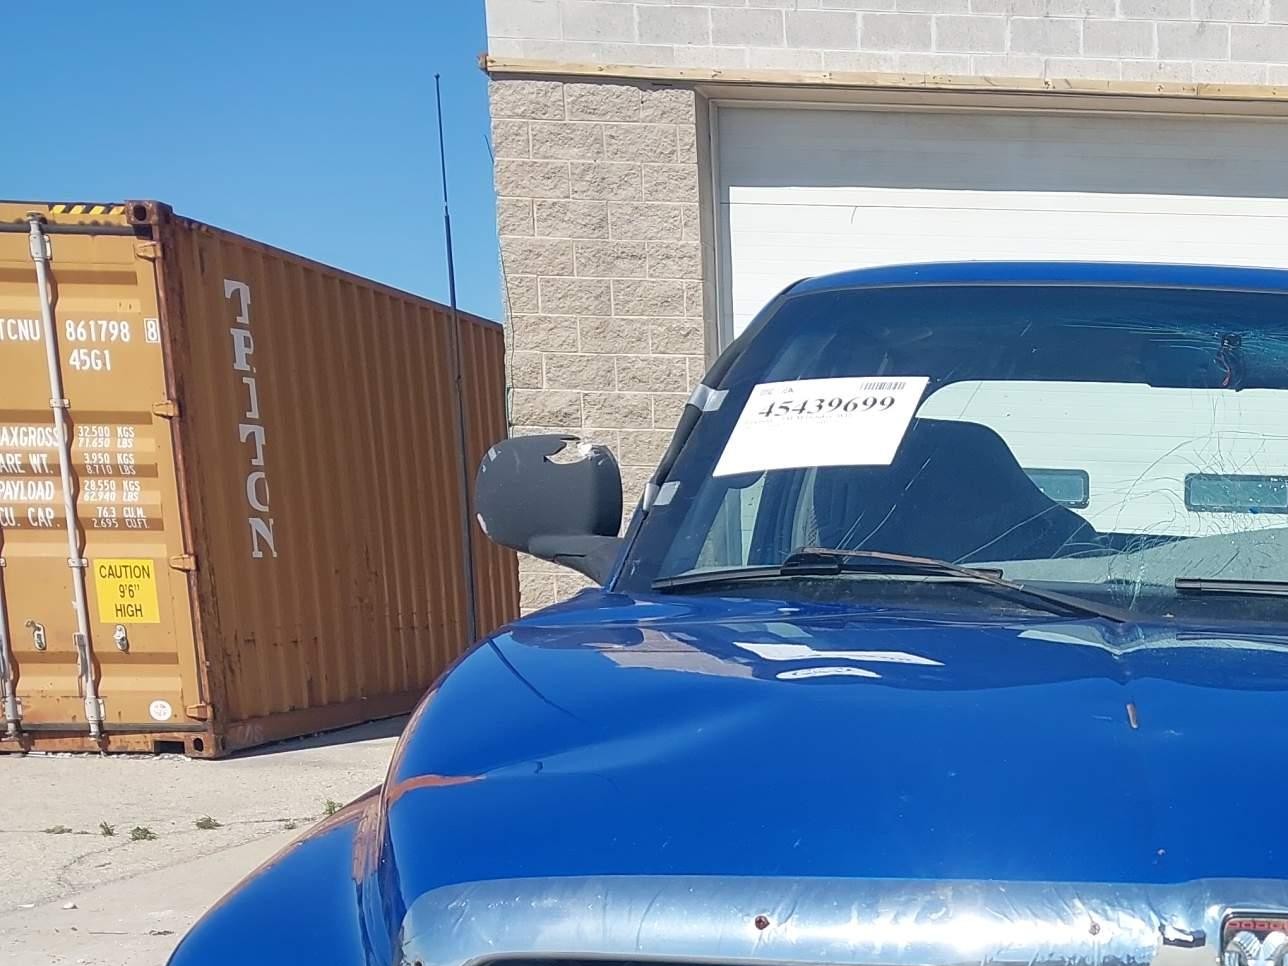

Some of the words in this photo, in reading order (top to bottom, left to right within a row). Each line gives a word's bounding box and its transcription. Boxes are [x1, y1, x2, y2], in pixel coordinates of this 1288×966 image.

[65, 319, 130, 342] 861798
[69, 349, 111, 371] 45G1
[758, 396, 896, 417] 45439699
[223, 279, 278, 557] TRITON
[117, 426, 135, 438] KGS
[117, 438, 133, 448] LBS
[29, 453, 54, 473] WT.
[117, 453, 135, 465] KGS
[118, 464, 136, 475] LBS
[0, 480, 54, 500] PAYLOAD
[122, 480, 141, 491] KGS
[28, 507, 61, 527] CAP.
[99, 564, 151, 579] CAUTION
[114, 603, 144, 617] HIGH
